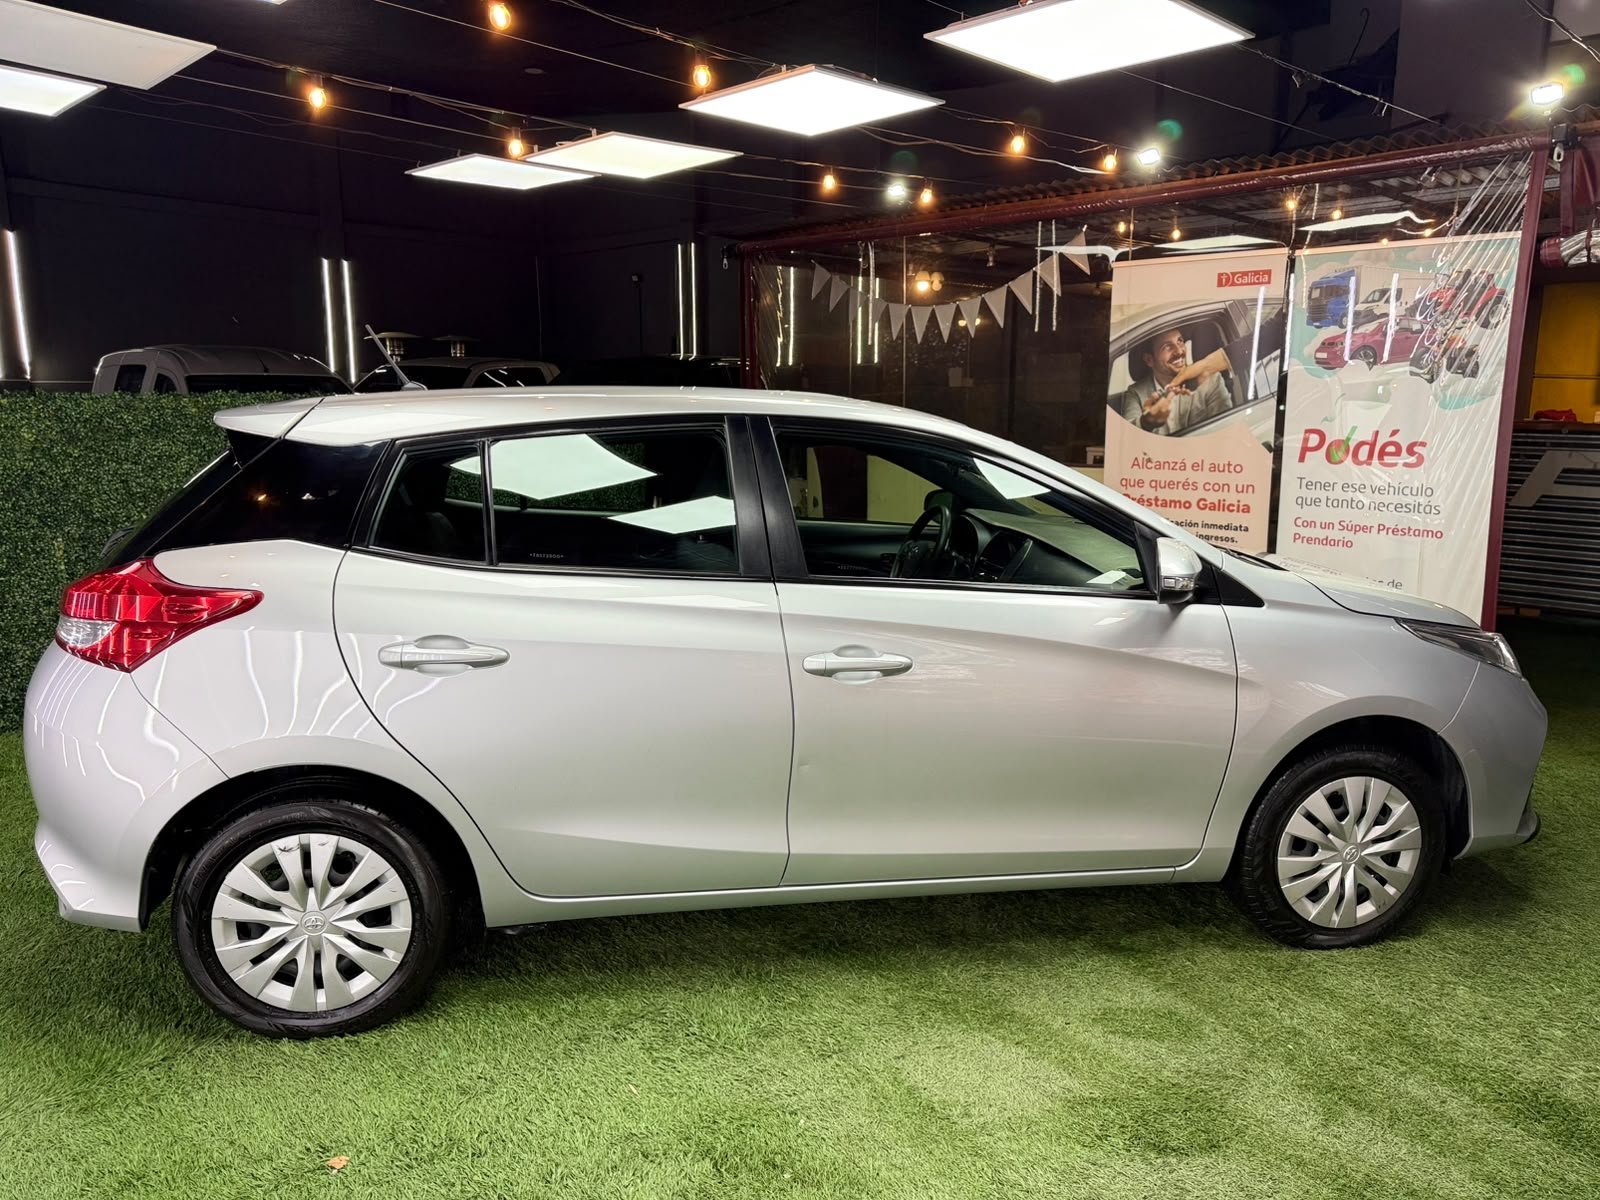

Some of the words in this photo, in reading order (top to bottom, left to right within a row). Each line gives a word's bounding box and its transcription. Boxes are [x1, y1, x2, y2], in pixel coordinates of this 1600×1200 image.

[1234, 272, 1269, 284] Galicia
[1298, 428, 1428, 468] Podés
[1131, 456, 1187, 472] Alcanzá
[1191, 459, 1205, 472] el
[1208, 460, 1244, 474] auto
[1120, 477, 1145, 490] que
[1149, 478, 1199, 491] querés
[1203, 481, 1231, 493] con
[1235, 483, 1256, 494] un
[1297, 477, 1338, 492] Tener
[1341, 482, 1367, 494] ese
[1370, 481, 1434, 498] vehículo
[1196, 497, 1251, 514] Galicia
[1295, 495, 1322, 509] que
[1325, 496, 1365, 511] tanto
[1368, 500, 1441, 516] necesitás
[1201, 520, 1249, 532] inmediata
[1294, 516, 1317, 529] Con
[1319, 520, 1335, 531] un
[1338, 520, 1374, 535] Súper
[1377, 523, 1444, 540] Préstamo
[1293, 532, 1354, 549] Prendario
